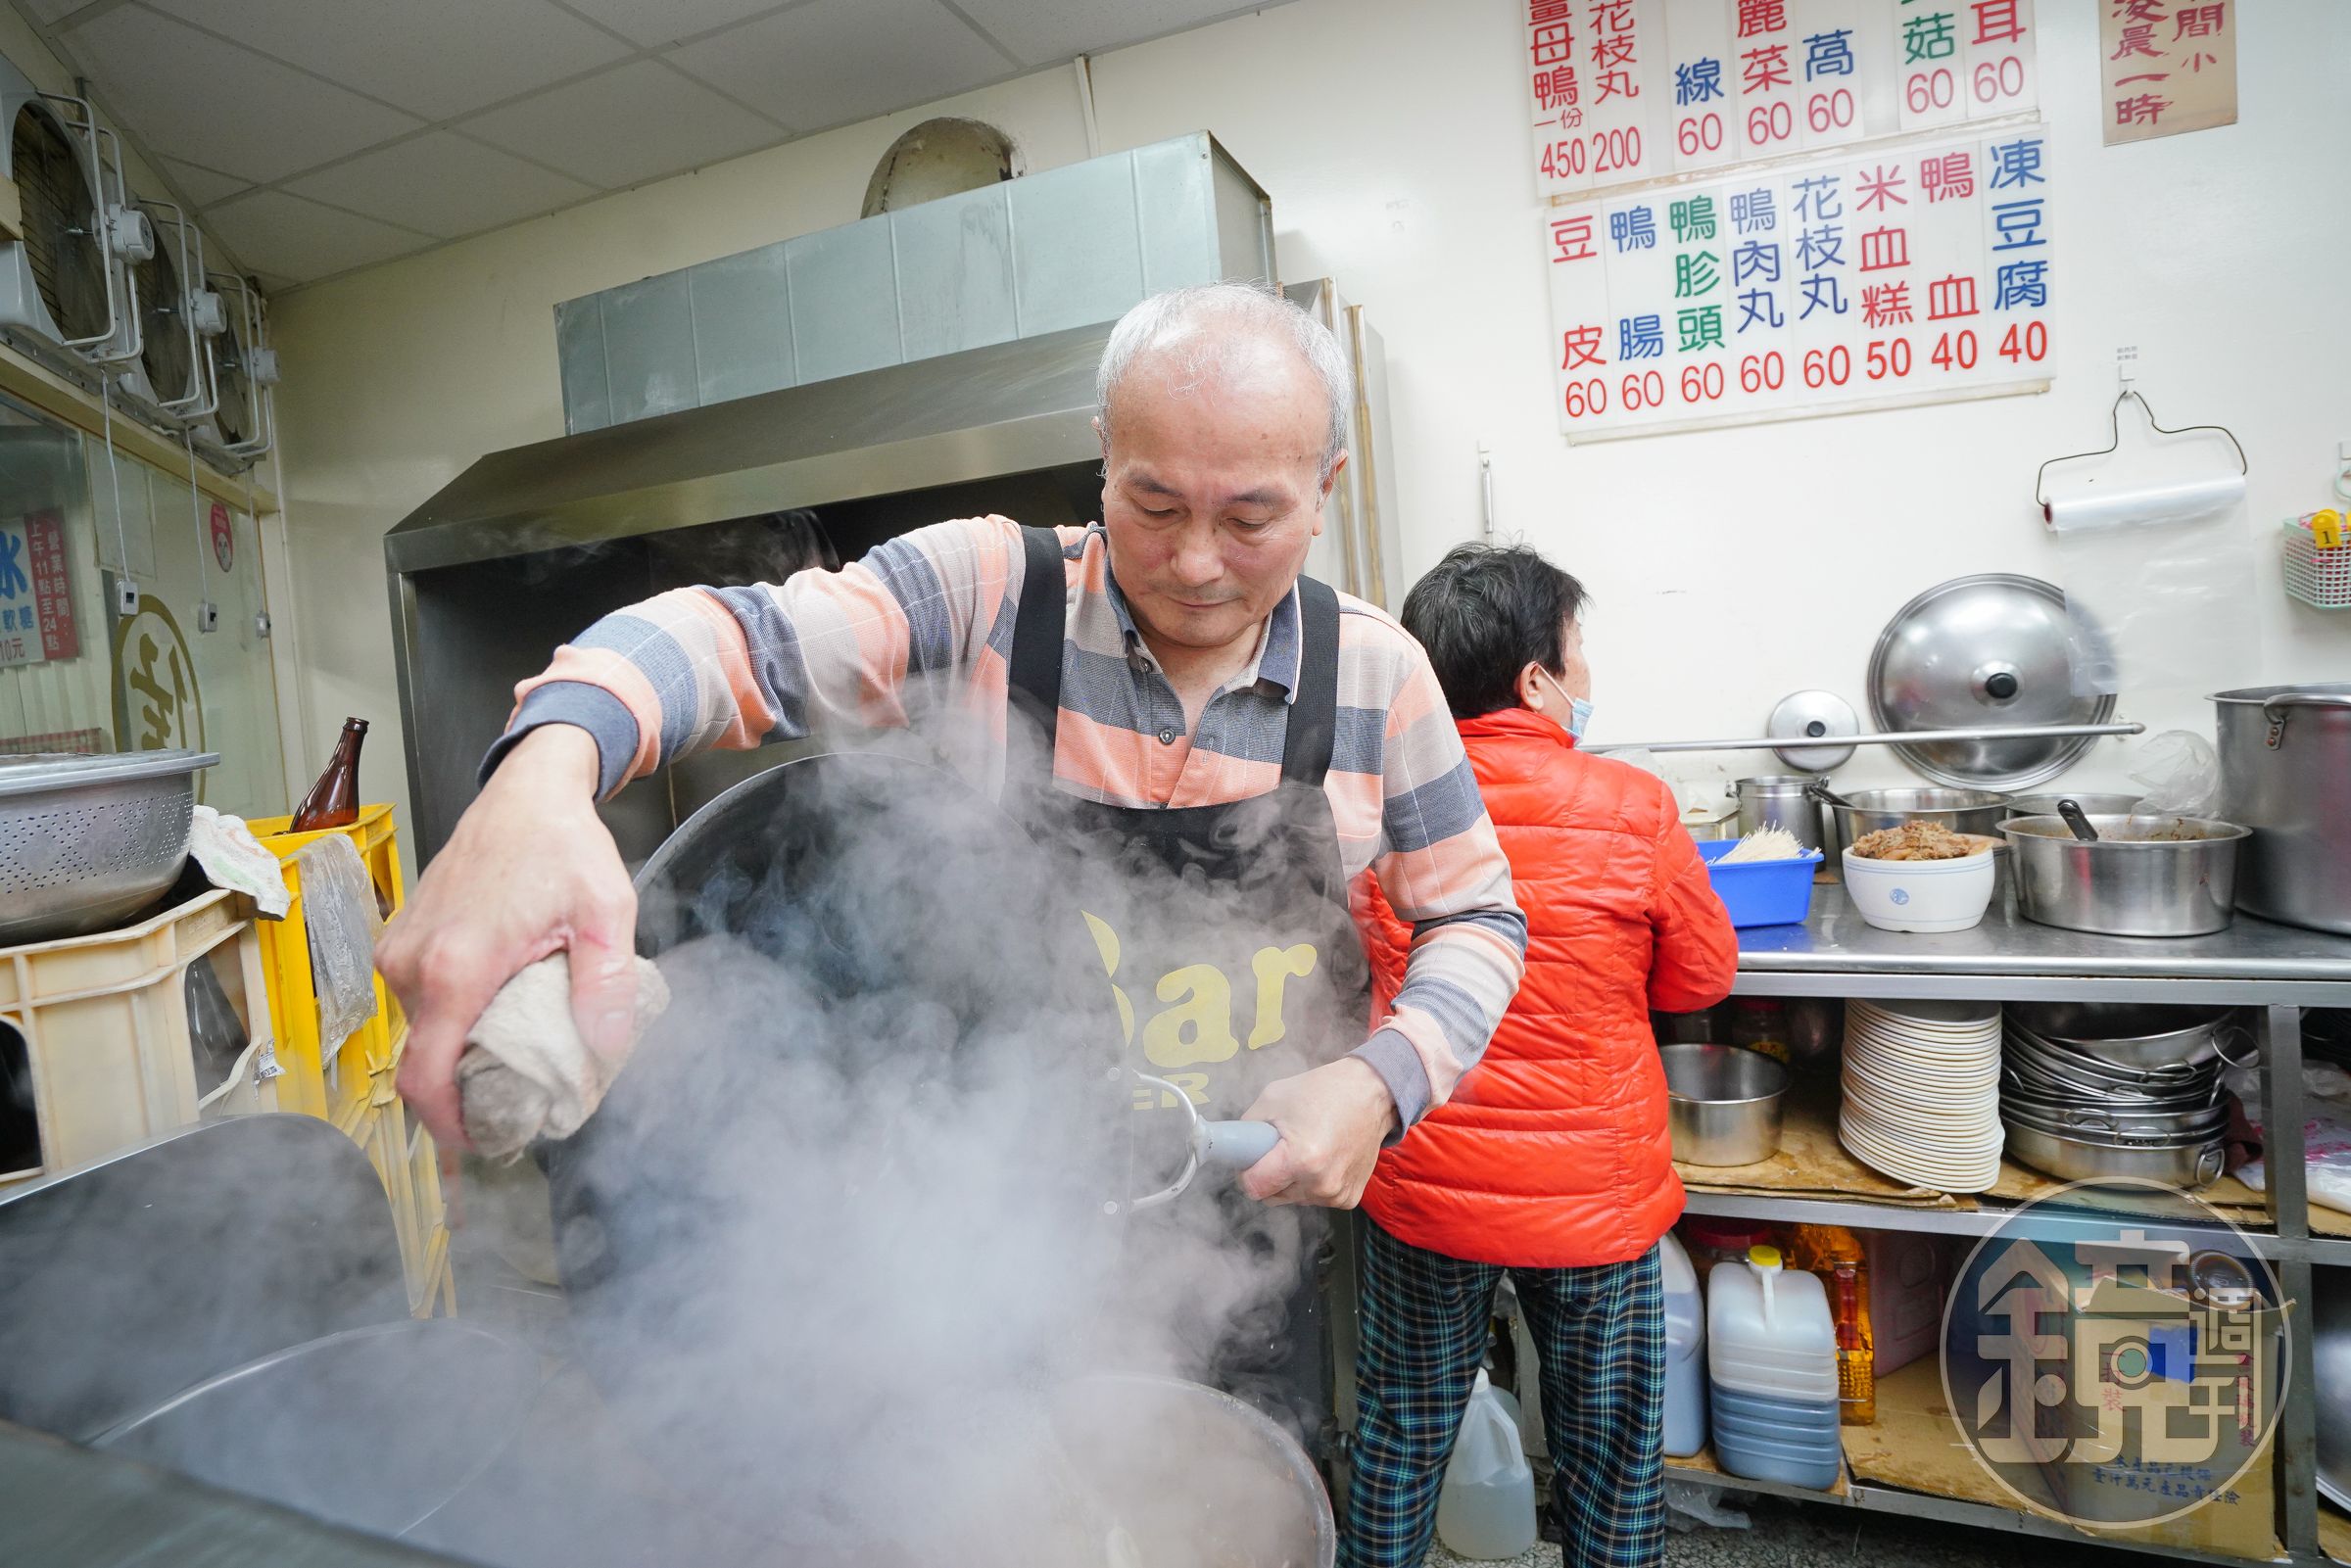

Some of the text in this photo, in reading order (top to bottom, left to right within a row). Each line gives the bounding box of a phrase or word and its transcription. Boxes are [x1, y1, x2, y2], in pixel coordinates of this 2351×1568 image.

[1901, 0, 1954, 64] 菇
[1970, 0, 2026, 45] 耳
[1588, 0, 1640, 105] 花枝丸
[1676, 58, 1723, 105] 線
[1907, 68, 1952, 113] 60
[1974, 56, 2024, 103] 60
[1748, 101, 1793, 145] 60
[1807, 88, 1853, 133] 60
[1592, 126, 1641, 173] 200
[1678, 113, 1723, 156] 60
[1540, 137, 1586, 178] 450
[1792, 174, 1848, 320] 花枝丸
[1920, 152, 1981, 321] 鴨血
[1990, 140, 2048, 310] 凍豆腐
[1730, 187, 1784, 334] 鴨肉丸
[1856, 168, 1913, 329] 米血糕
[1551, 214, 1607, 371] 豆皮
[1609, 206, 1664, 361] 鴨腸
[1670, 196, 1725, 352] 鴨胗頭
[1866, 337, 1912, 381] 50
[1931, 329, 1978, 372] 40
[1997, 320, 2048, 363] 40
[1680, 361, 1725, 404] 60
[1740, 351, 1785, 394] 60
[1802, 344, 1850, 389] 60
[1565, 377, 1607, 418] 60
[1621, 370, 1664, 411] 60
